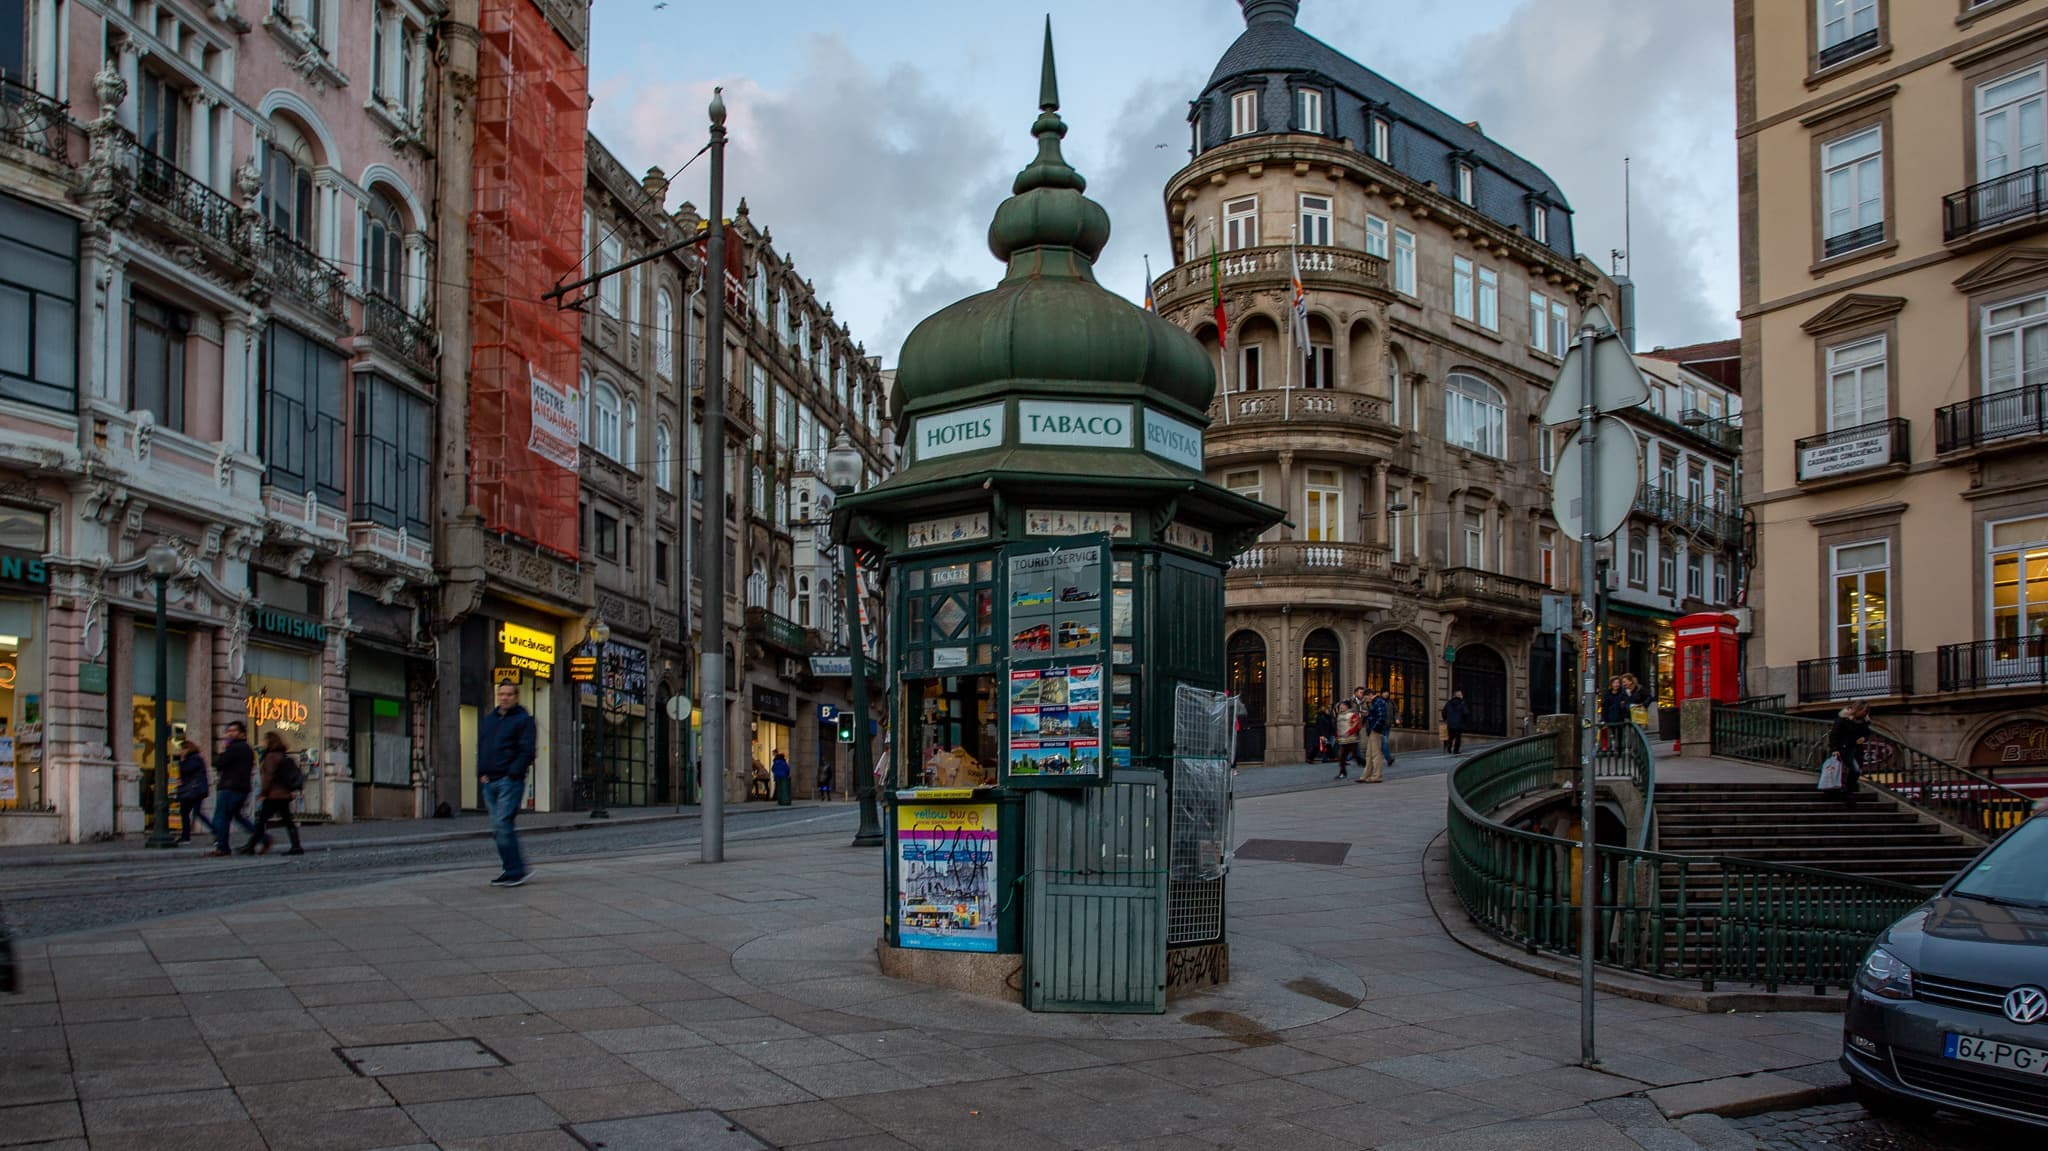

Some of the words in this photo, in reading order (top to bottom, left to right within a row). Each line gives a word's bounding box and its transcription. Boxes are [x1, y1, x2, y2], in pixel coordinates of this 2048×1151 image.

[927, 418, 992, 447] HOTELS
[1028, 415, 1122, 435] TABACO
[1147, 422, 1199, 458] REVISTAS
[1822, 459, 1865, 473] ADVOGADOS
[1015, 555, 1056, 570] TOURIST
[1056, 551, 1098, 565] SERVICE
[931, 568, 970, 583] TICKETS
[256, 610, 327, 641] TURISMO
[497, 669, 517, 677] ATM
[511, 656, 551, 673] EXCHANGE
[949, 808, 966, 819] bus
